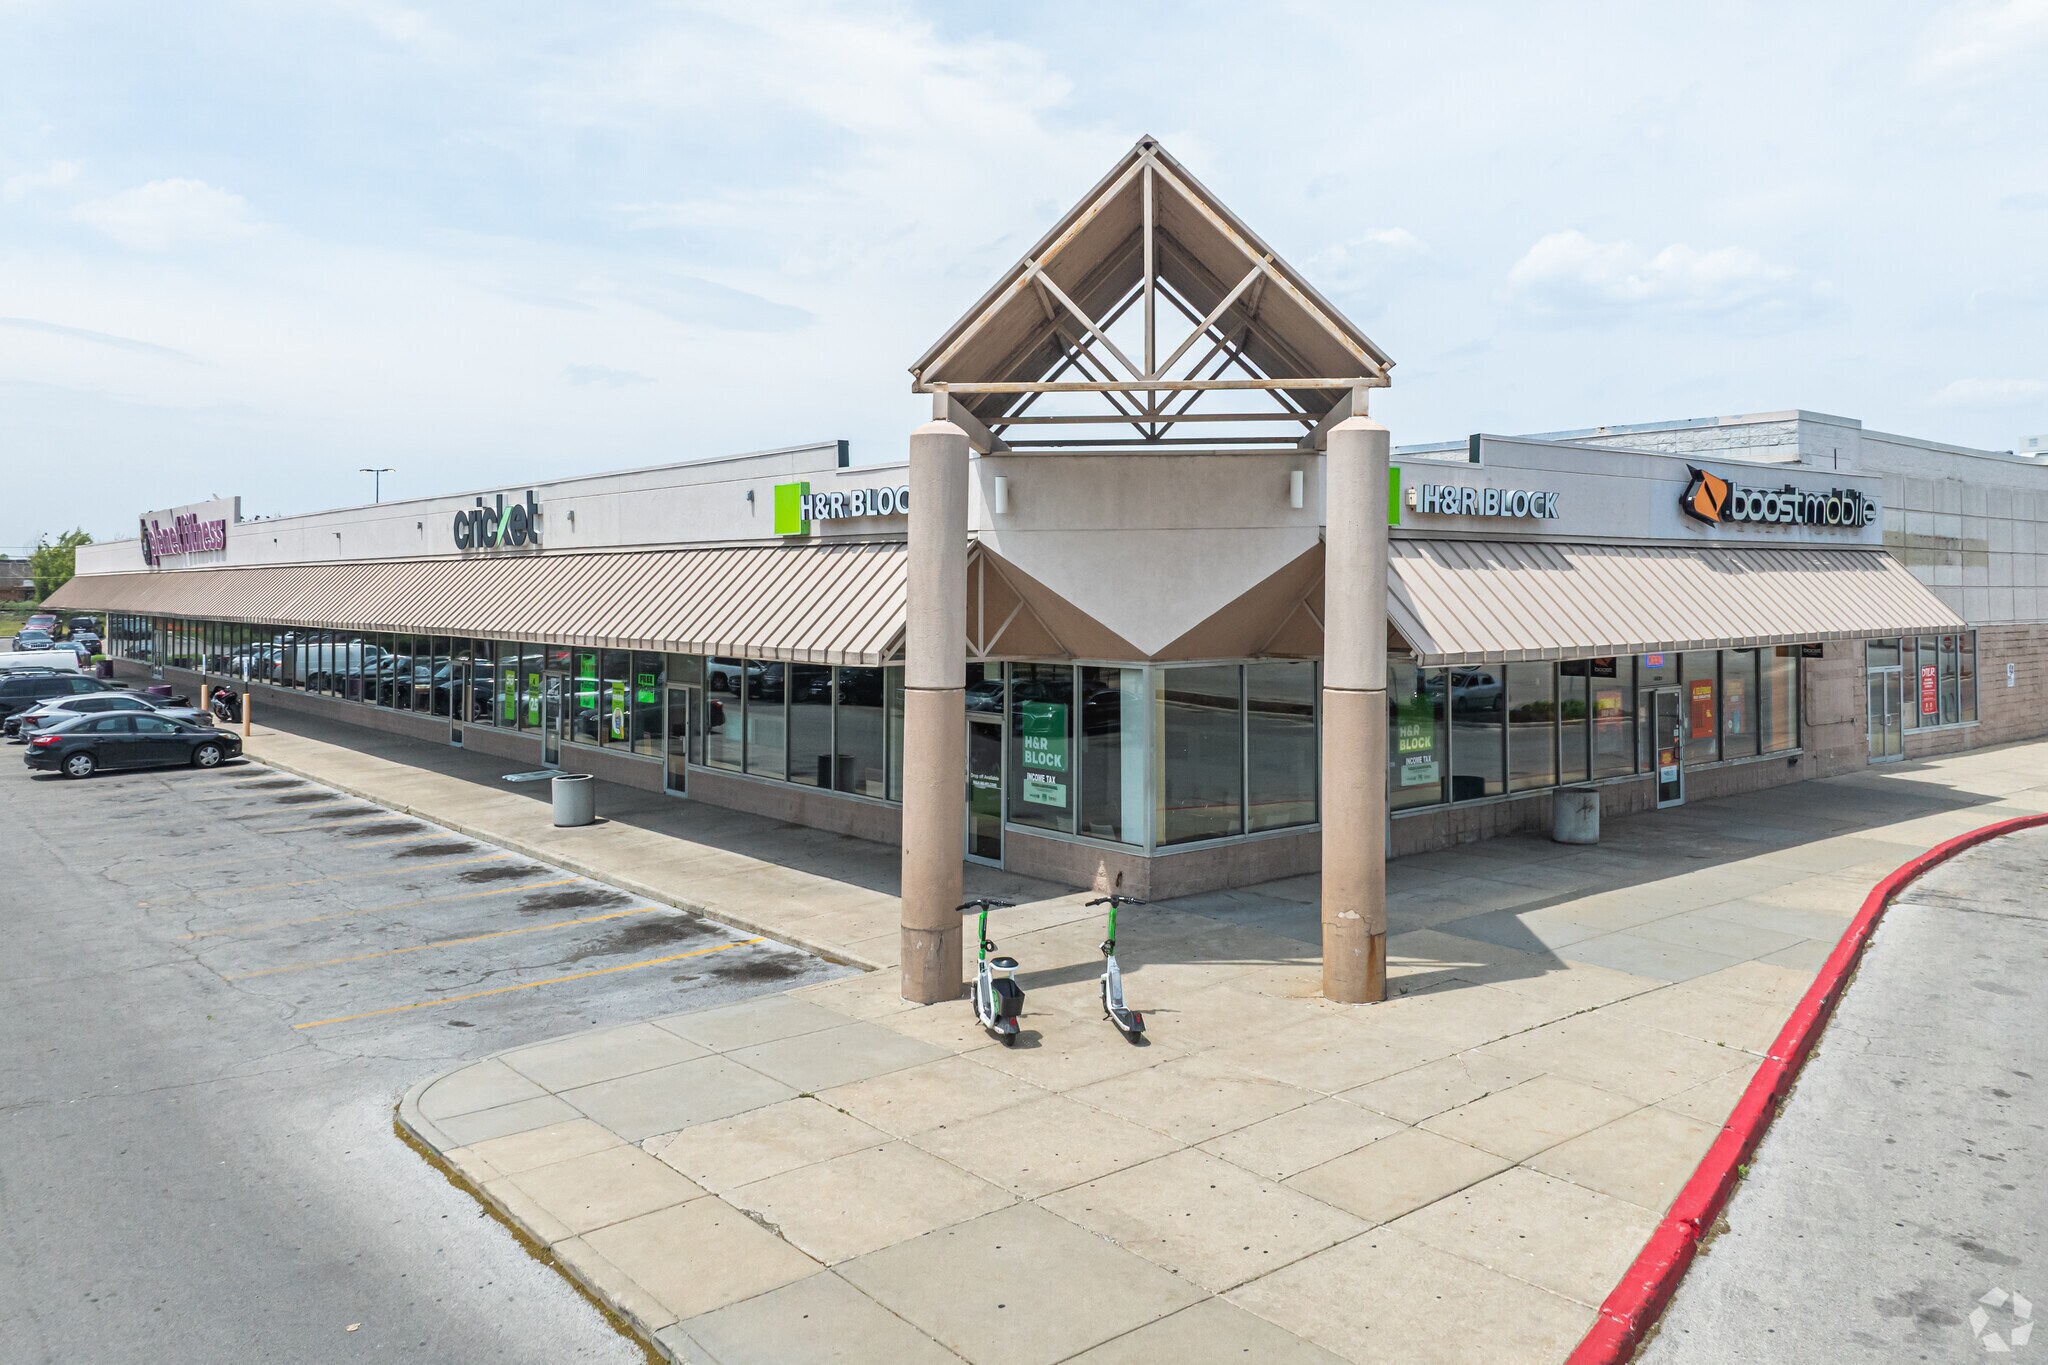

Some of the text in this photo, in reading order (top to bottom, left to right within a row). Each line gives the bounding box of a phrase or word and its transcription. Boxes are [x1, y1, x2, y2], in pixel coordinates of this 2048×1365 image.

[800, 485, 910, 520] H&R BLOC
[1422, 484, 1560, 519] H&R BLOCK
[453, 489, 538, 550] cricket
[1399, 724, 1421, 738] H&R
[1024, 735, 1048, 751] H&R
[1399, 735, 1432, 751] BLOCK
[1024, 750, 1063, 768] BLOCK
[1405, 754, 1432, 766] INCOME TAX
[1026, 772, 1056, 785] INCOME TAX
